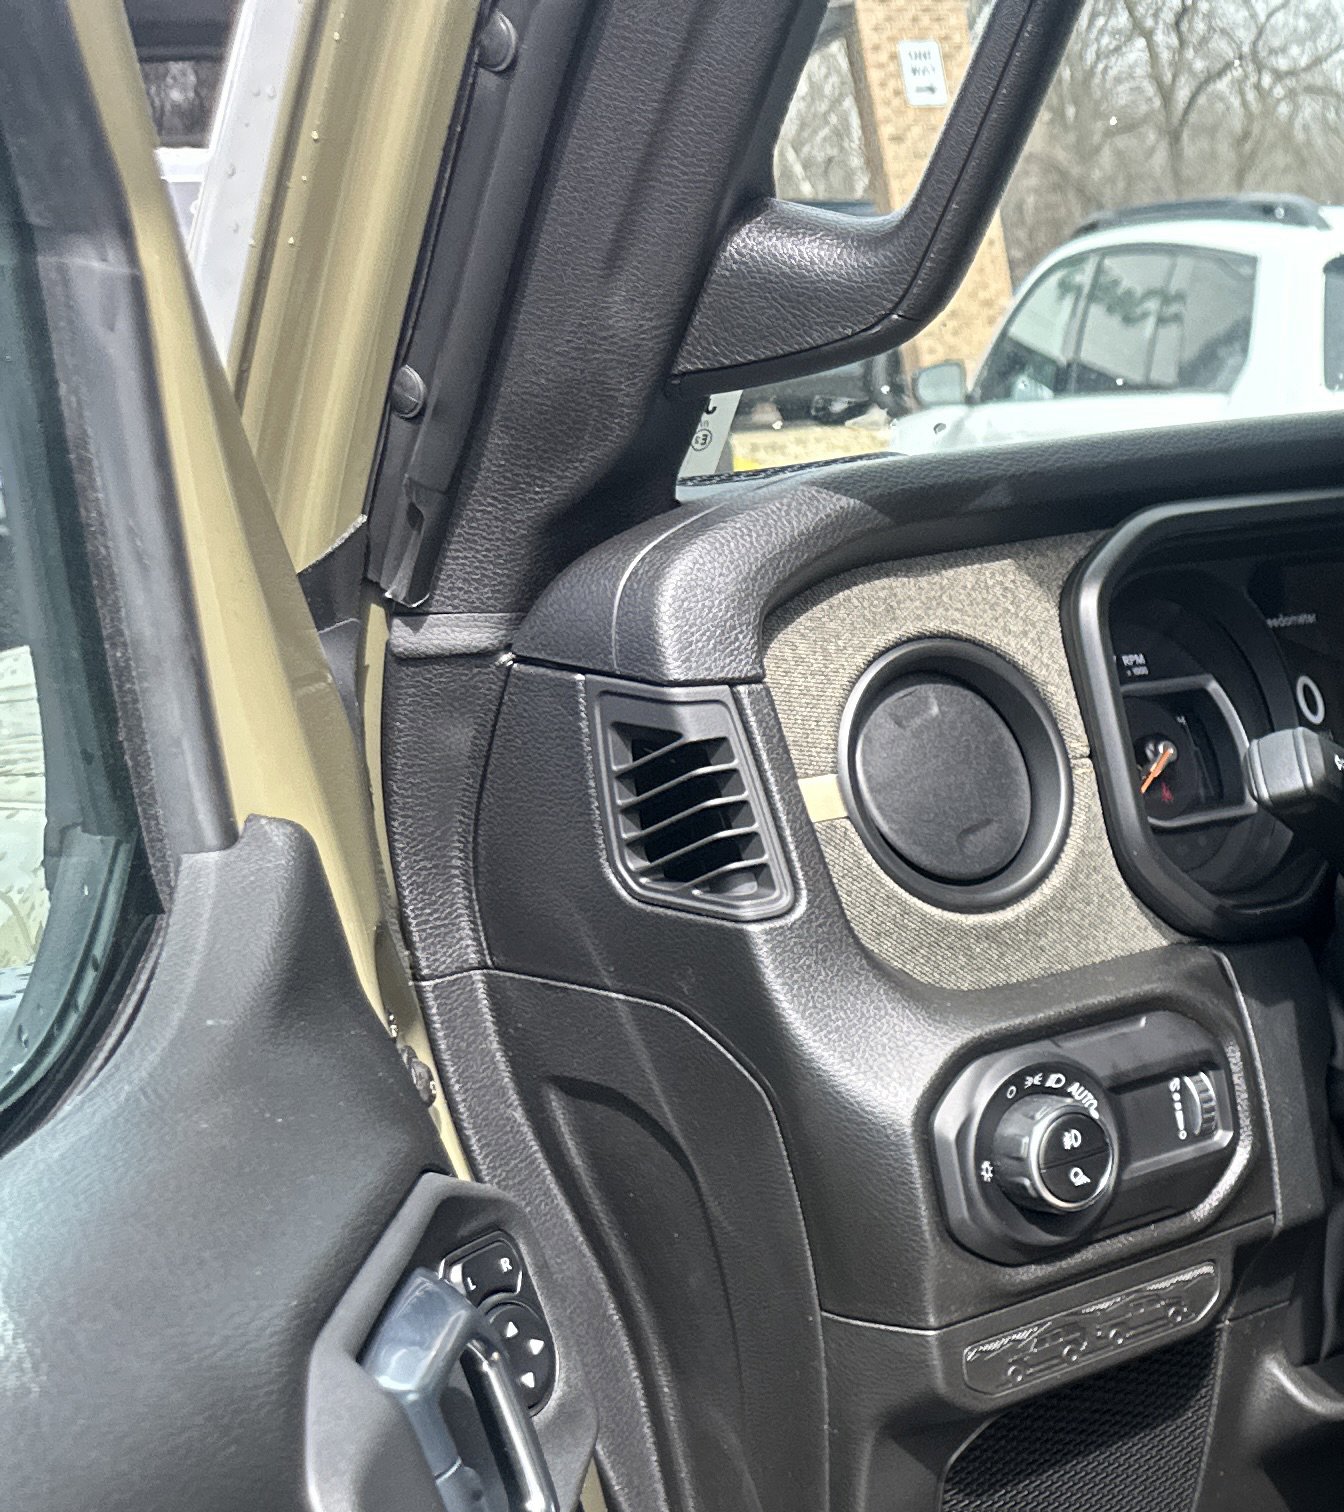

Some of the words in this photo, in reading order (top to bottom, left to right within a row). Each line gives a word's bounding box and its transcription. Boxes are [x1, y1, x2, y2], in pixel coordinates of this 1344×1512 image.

[911, 65, 936, 77] WAY
[1121, 653, 1146, 666] RPM
[1296, 675, 1325, 725] 0
[1067, 1082, 1100, 1120] AUTO
[499, 1257, 513, 1273] R
[466, 1276, 477, 1291] L
